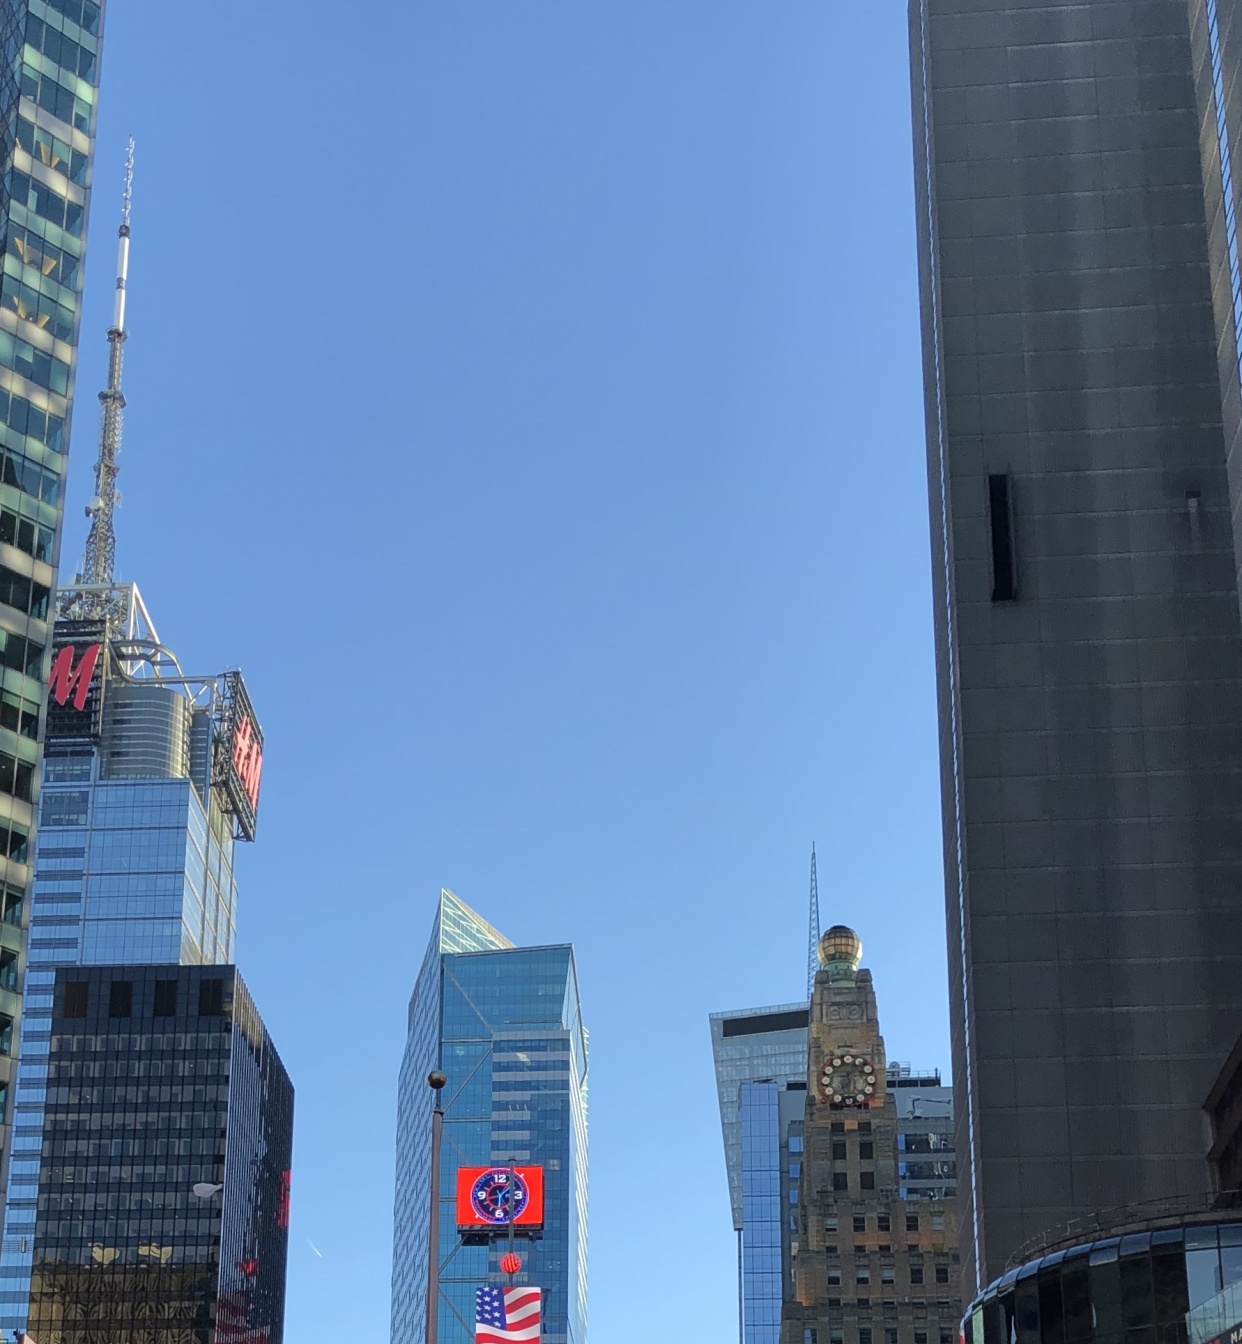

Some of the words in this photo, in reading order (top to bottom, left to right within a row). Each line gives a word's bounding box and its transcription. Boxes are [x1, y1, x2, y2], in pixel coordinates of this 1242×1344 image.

[494, 1175, 507, 1183] 12
[477, 1191, 486, 1200] 9
[514, 1191, 523, 1200] 3
[495, 1210, 504, 1218] 6
